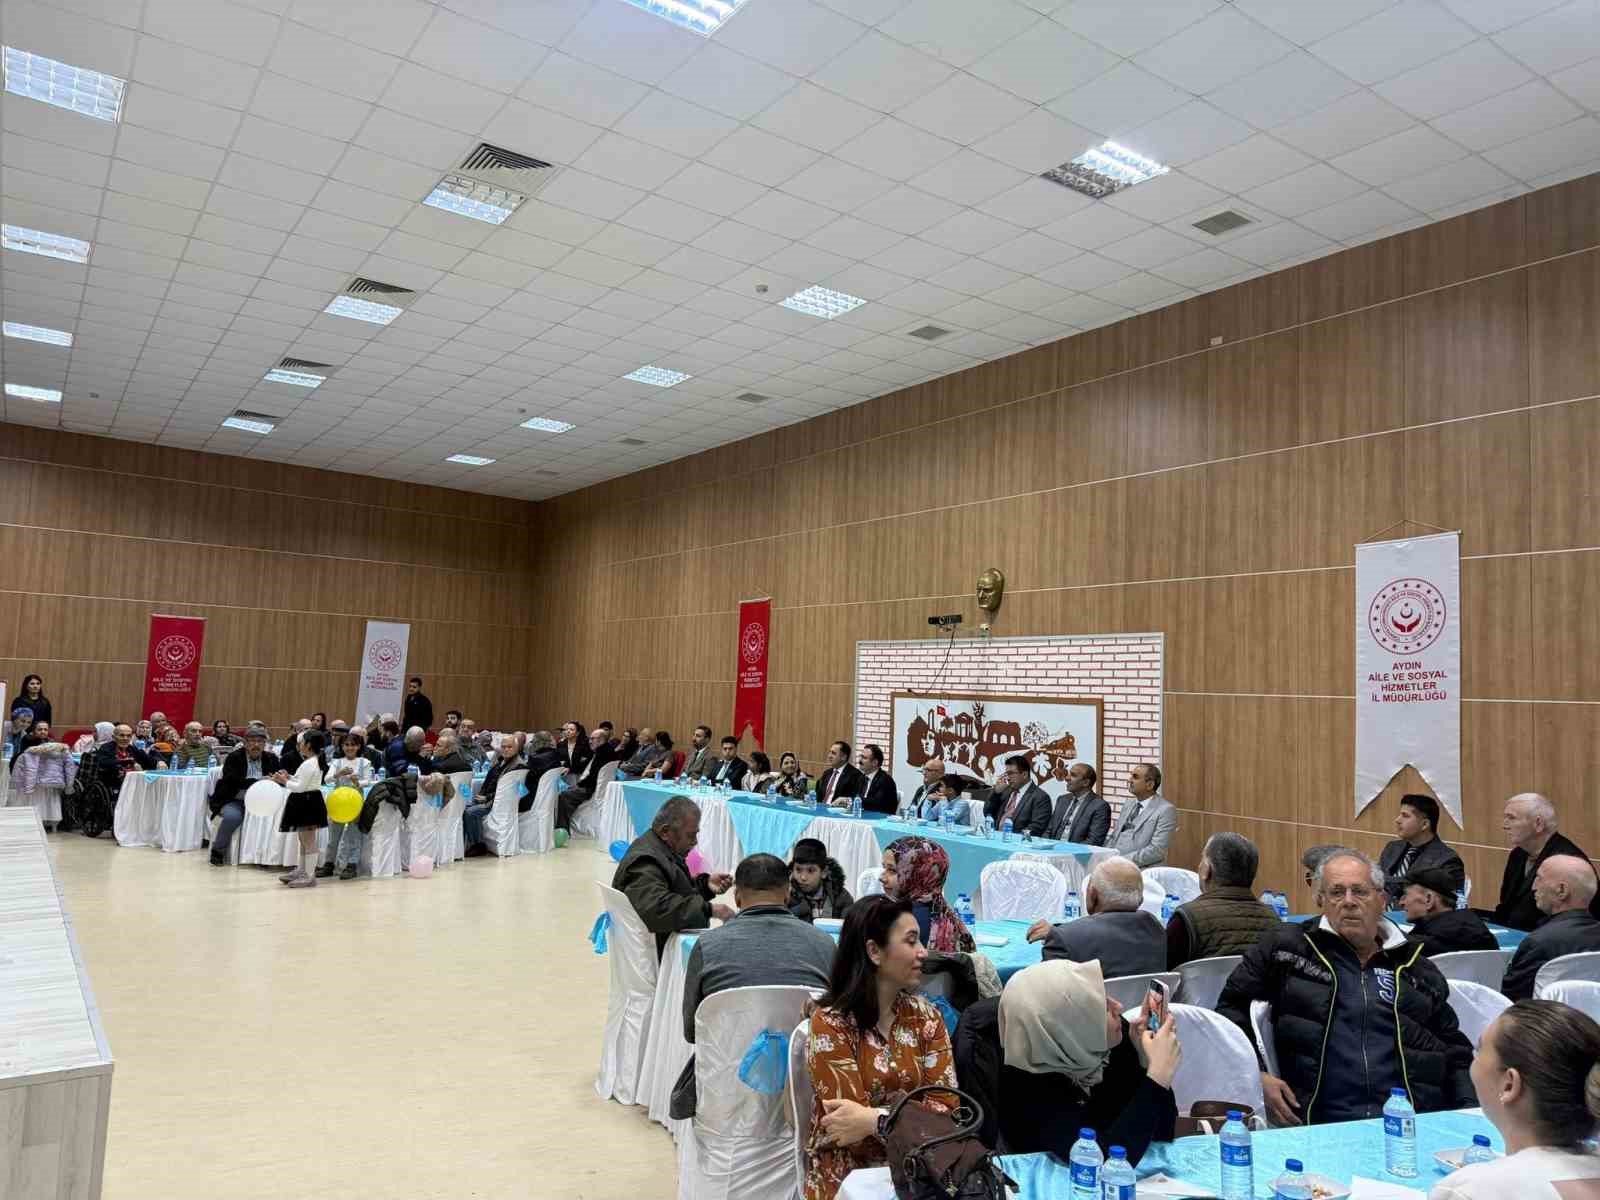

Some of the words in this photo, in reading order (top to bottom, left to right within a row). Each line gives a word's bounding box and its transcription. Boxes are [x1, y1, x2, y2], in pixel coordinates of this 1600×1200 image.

[1392, 661, 1422, 670] AYDIN
[1368, 672, 1390, 682] AİLE
[1392, 672, 1405, 681] VE
[1407, 670, 1448, 681] SOSYAL
[1381, 682, 1437, 692] HİZMETLER
[1371, 692, 1380, 702] İL
[1382, 691, 1447, 702] MÜDÜRLÜĞÜ
